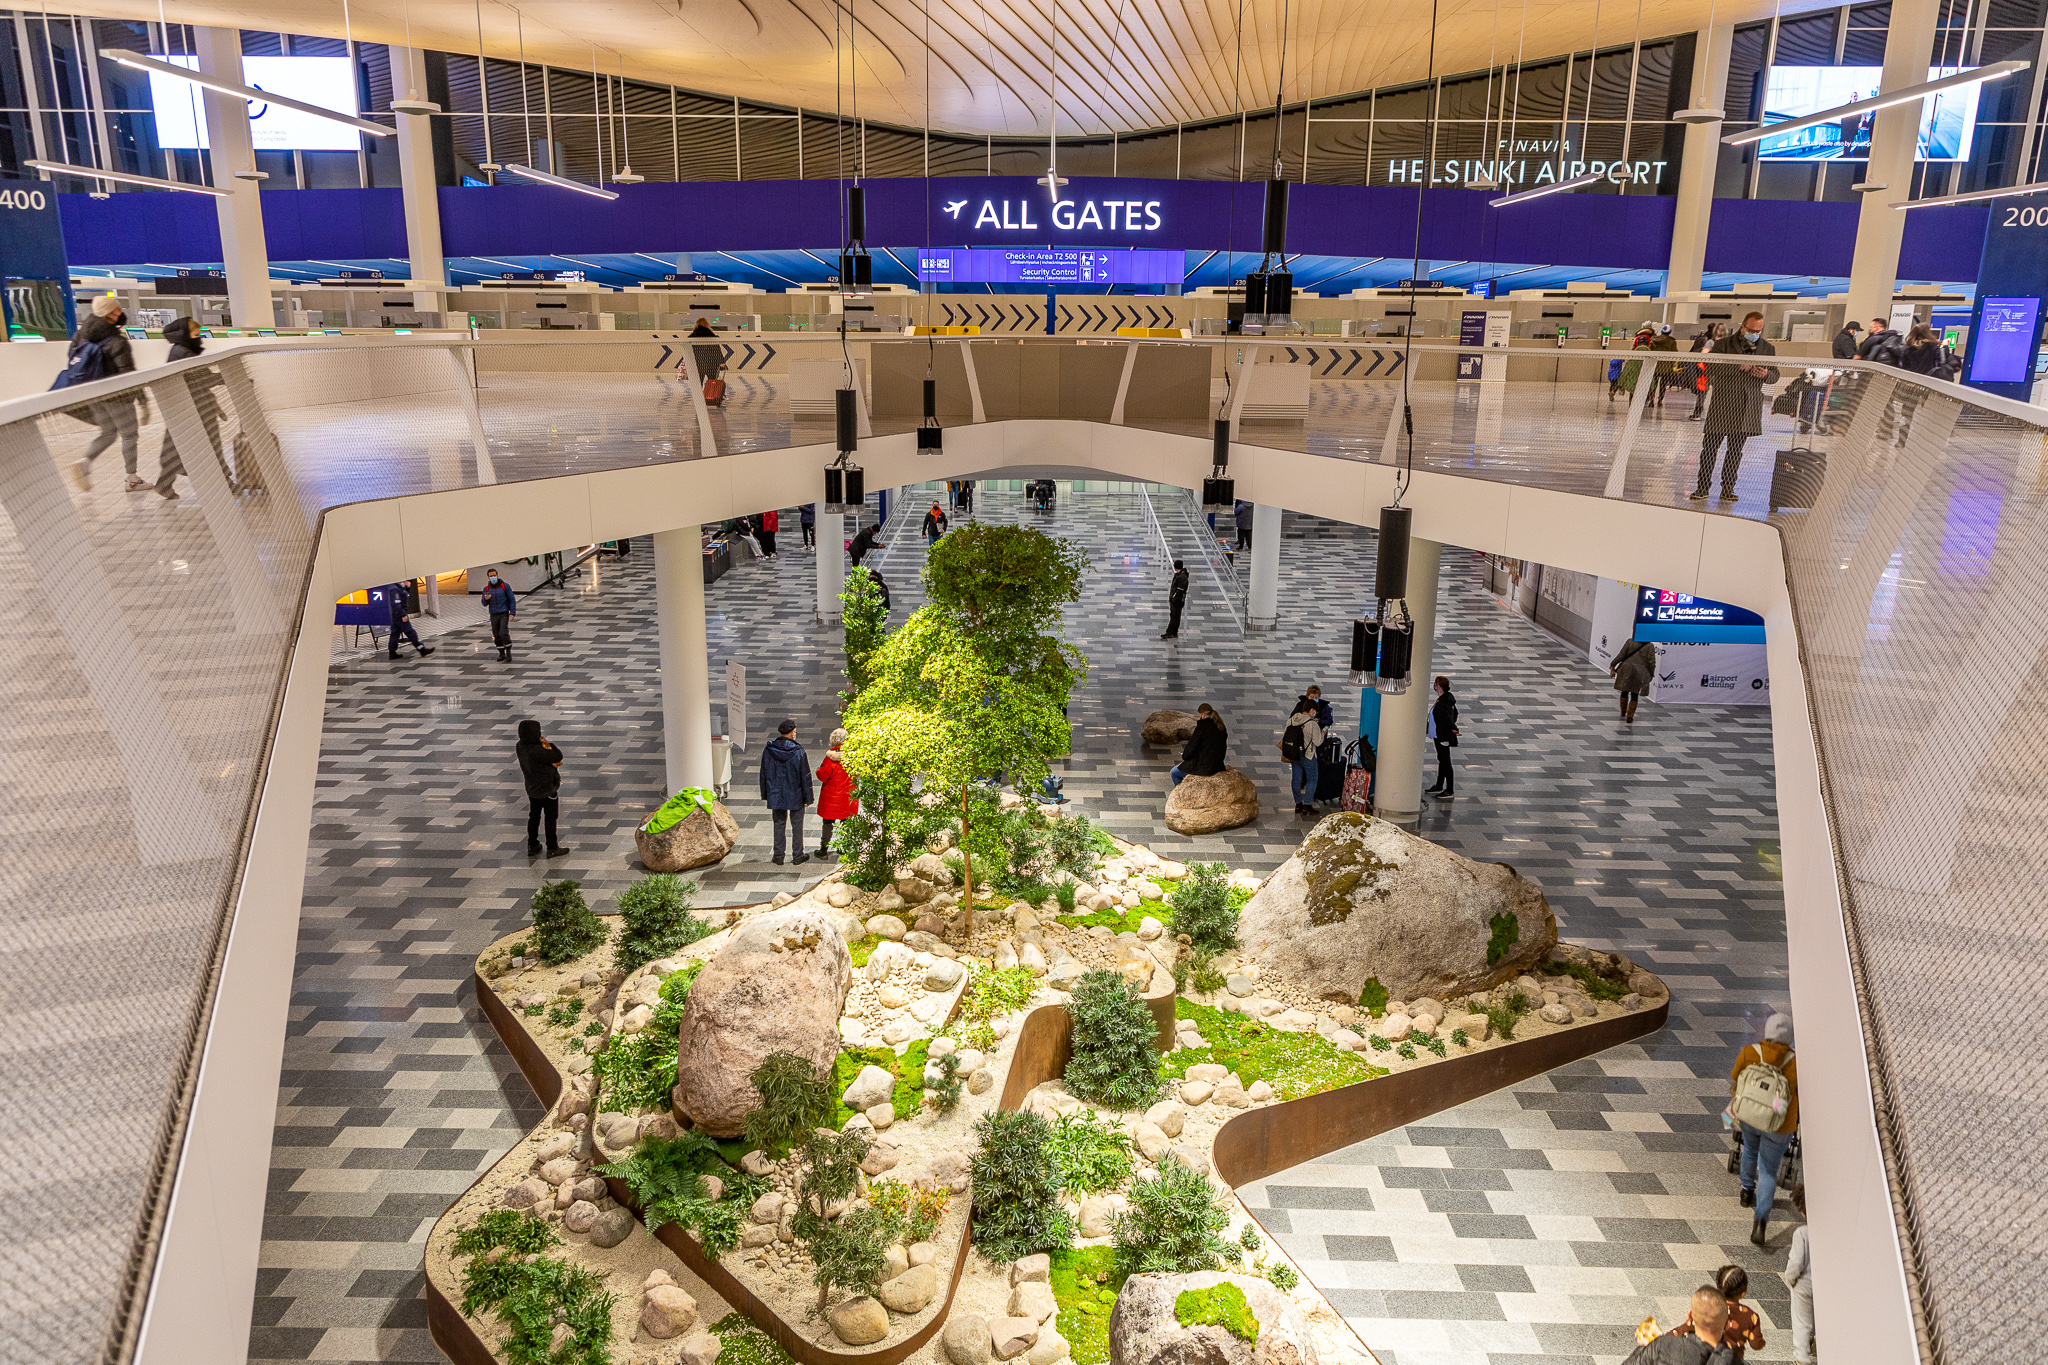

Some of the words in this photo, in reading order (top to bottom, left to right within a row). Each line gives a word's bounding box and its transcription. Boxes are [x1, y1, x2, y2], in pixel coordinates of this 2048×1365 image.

[1498, 139, 1571, 153] FINAVIA
[1388, 159, 1526, 184] HELSINKI
[1535, 160, 1668, 185] AIRPORT
[0, 189, 46, 210] 400
[974, 199, 1038, 230] ALL
[1051, 200, 1162, 231] GATES
[2003, 206, 2048, 227] 200
[1005, 252, 1035, 260] Check-in
[1022, 268, 1050, 277] Security
[1051, 268, 1077, 276] Control
[1661, 593, 1674, 603] 2A
[1675, 608, 1698, 616] Arrival
[1698, 608, 1724, 616] Service
[1709, 674, 1738, 682] airport
[1709, 682, 1735, 690] dining
